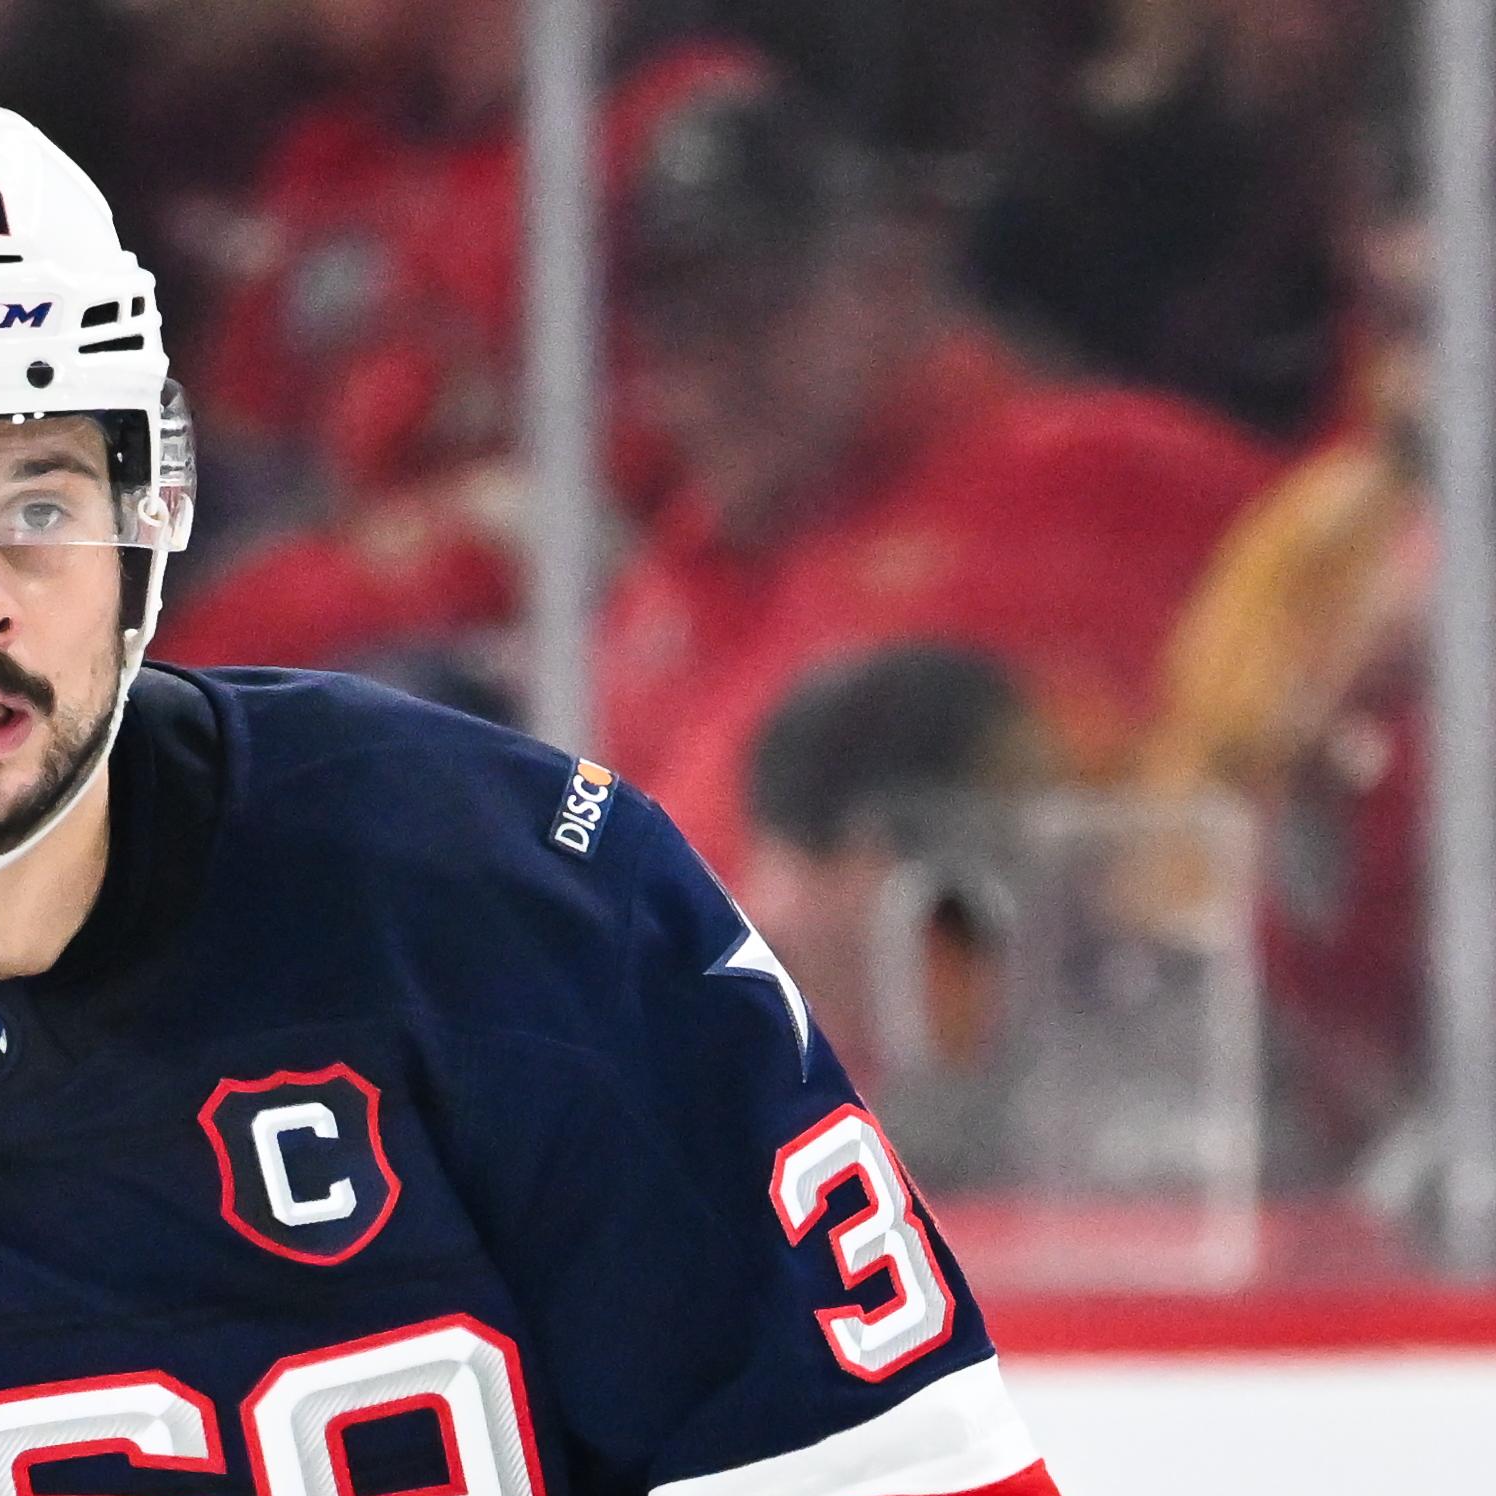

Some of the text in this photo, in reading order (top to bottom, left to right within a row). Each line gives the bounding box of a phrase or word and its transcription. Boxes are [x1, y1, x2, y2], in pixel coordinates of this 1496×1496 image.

[554, 757, 614, 853] DISCO
[251, 1102, 357, 1227] C
[768, 1102, 956, 1383] 3
